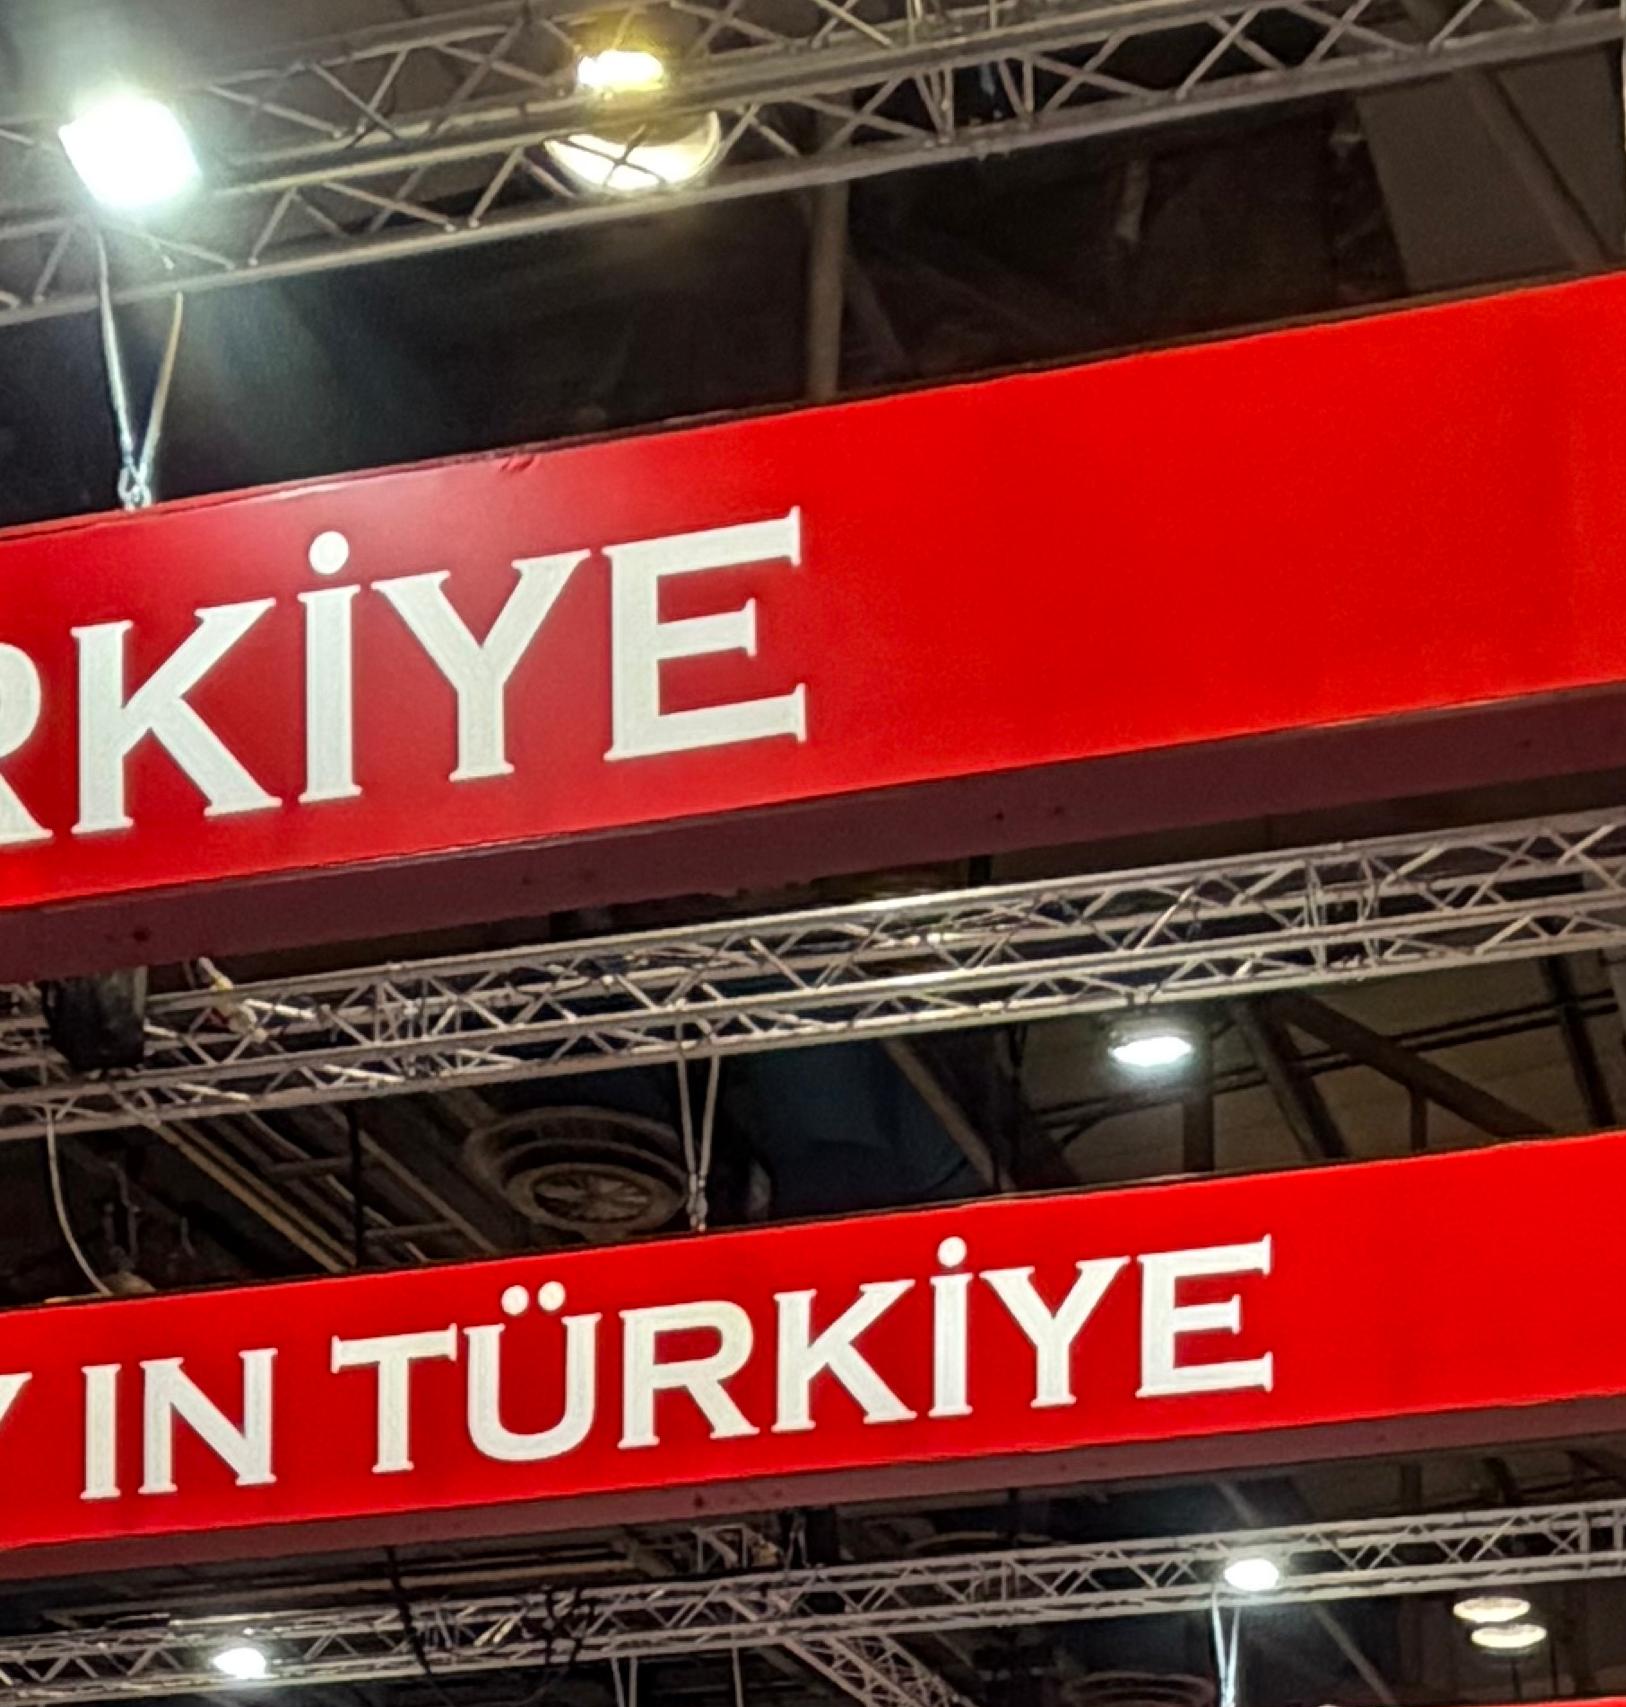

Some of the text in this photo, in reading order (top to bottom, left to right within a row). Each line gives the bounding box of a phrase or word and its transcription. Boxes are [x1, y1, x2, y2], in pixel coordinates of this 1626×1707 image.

[0, 504, 807, 846] KİYE
[80, 1232, 1275, 1501] IN TÜRKİYE
